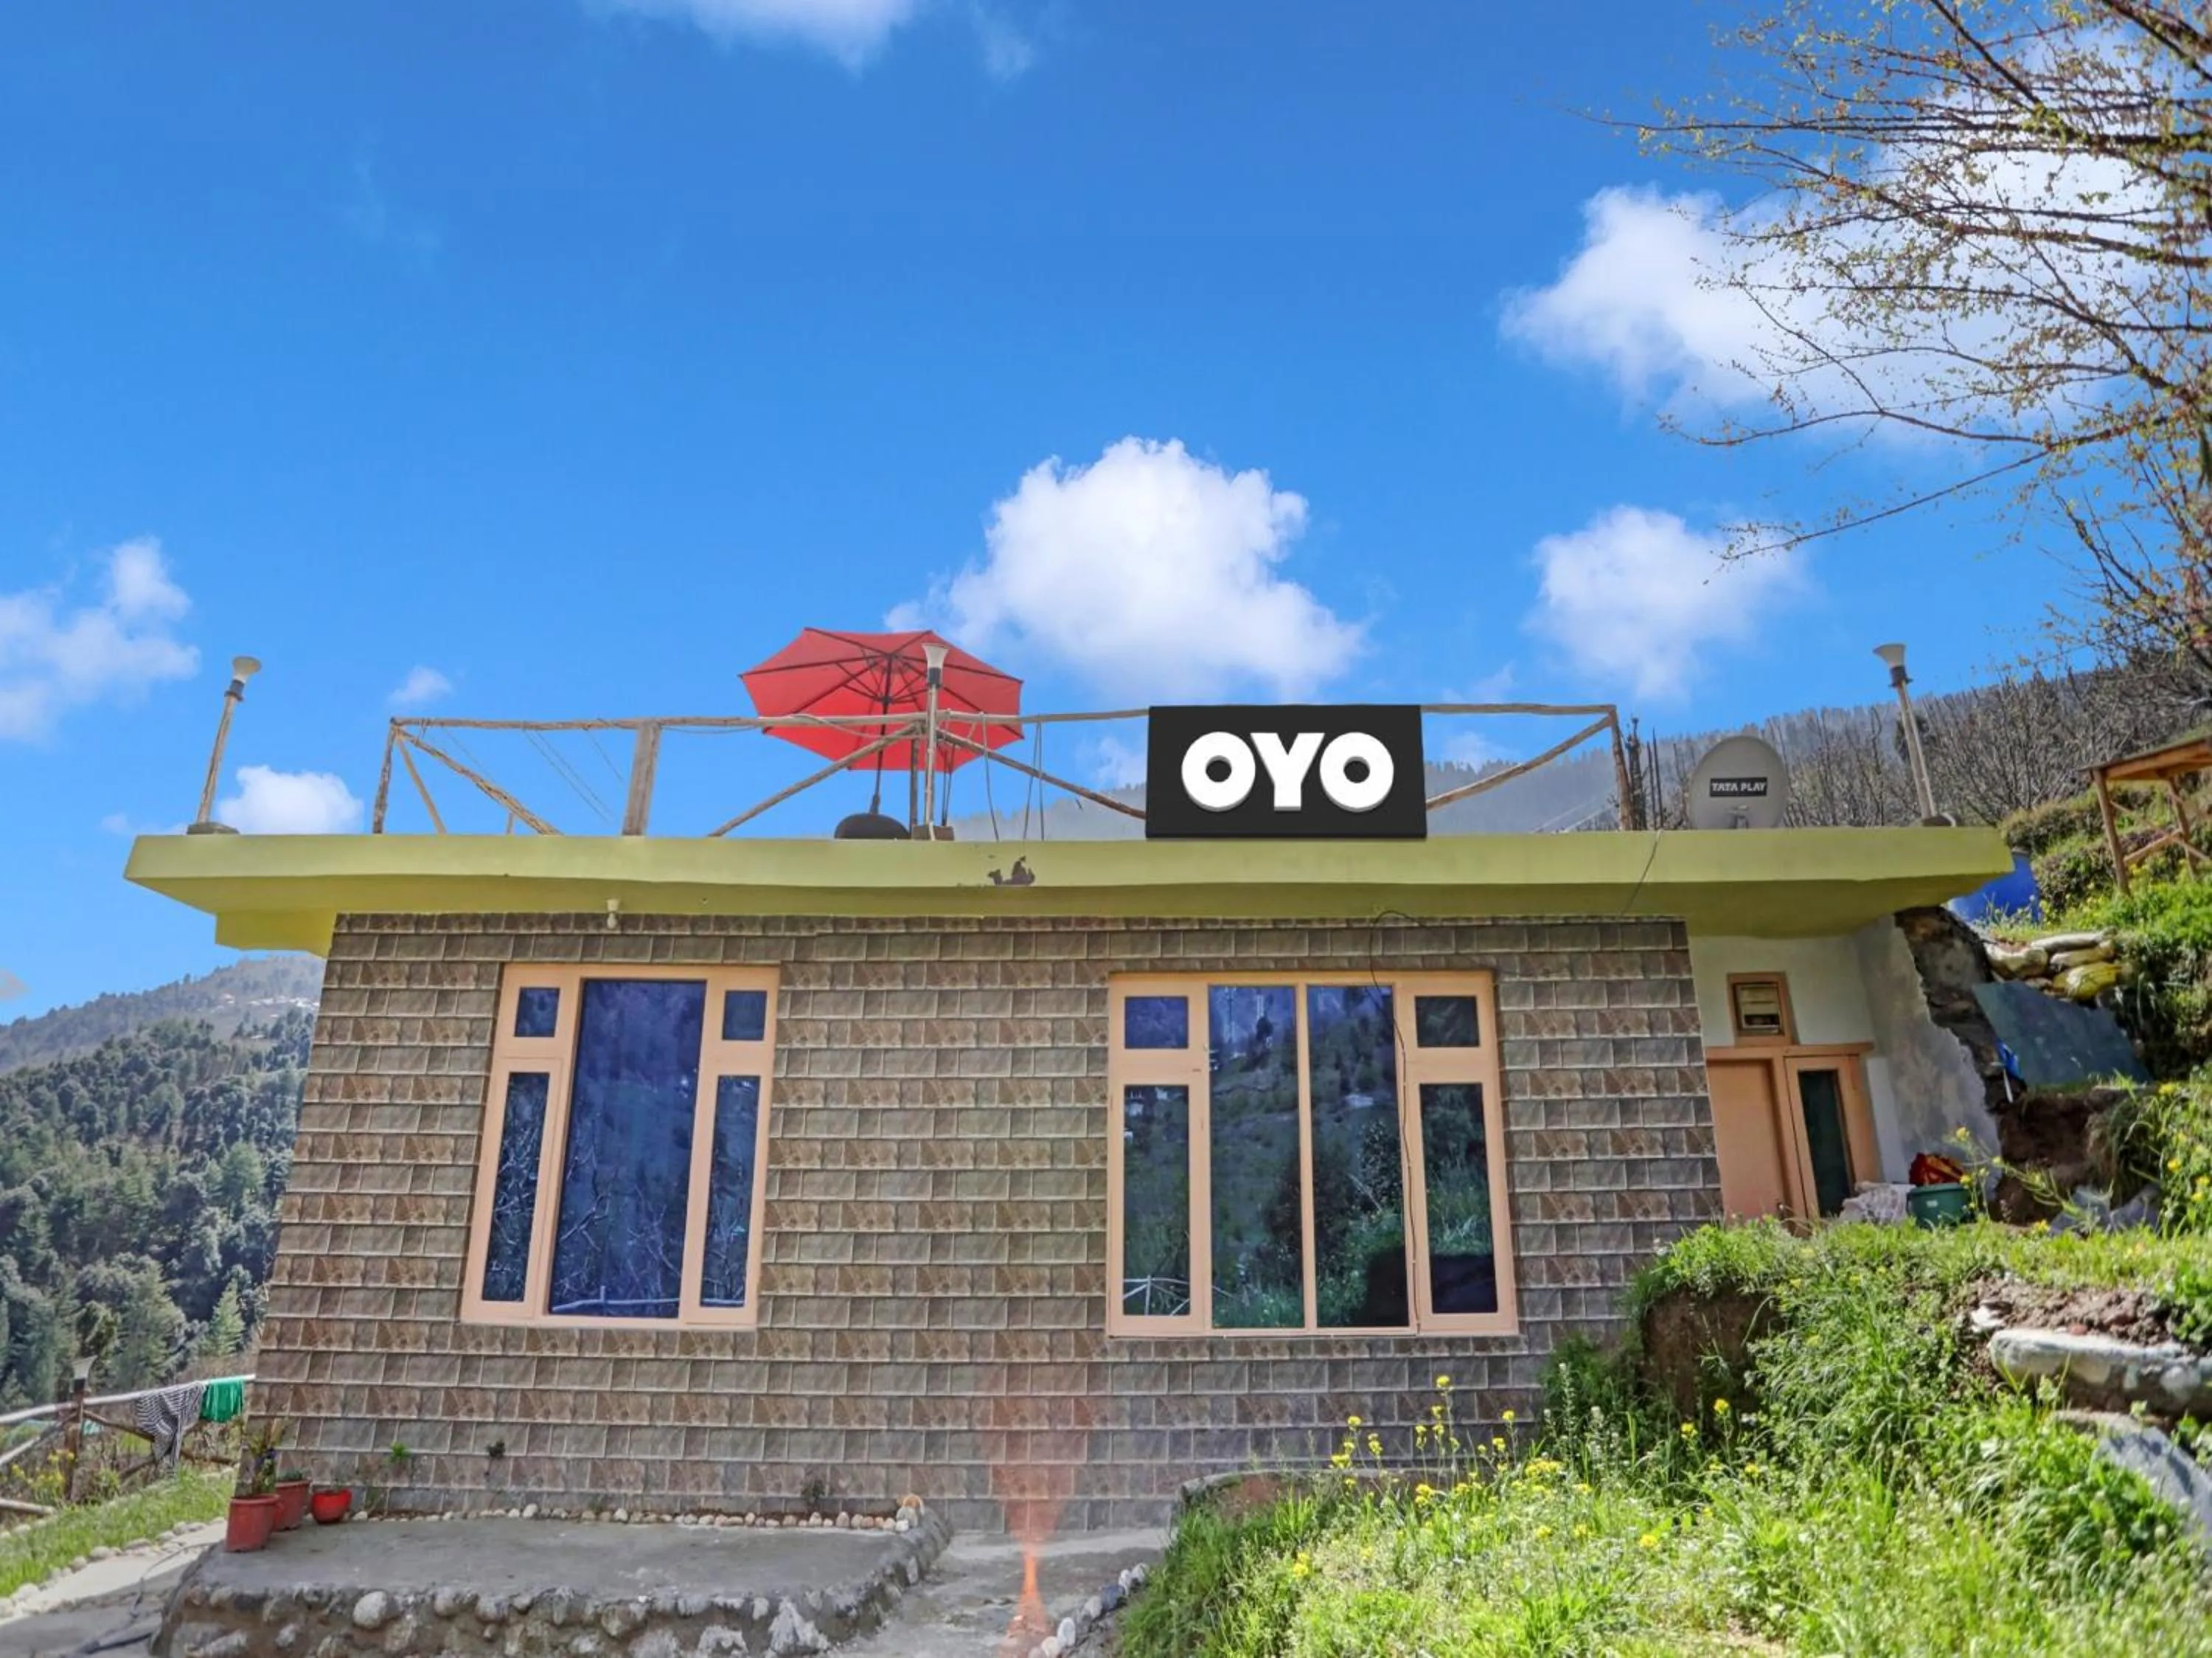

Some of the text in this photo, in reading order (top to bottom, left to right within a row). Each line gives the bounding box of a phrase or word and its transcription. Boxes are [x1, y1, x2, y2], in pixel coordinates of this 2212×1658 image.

[1181, 732, 1394, 811] OYO
[1712, 782, 1766, 791] TATA PLAY
